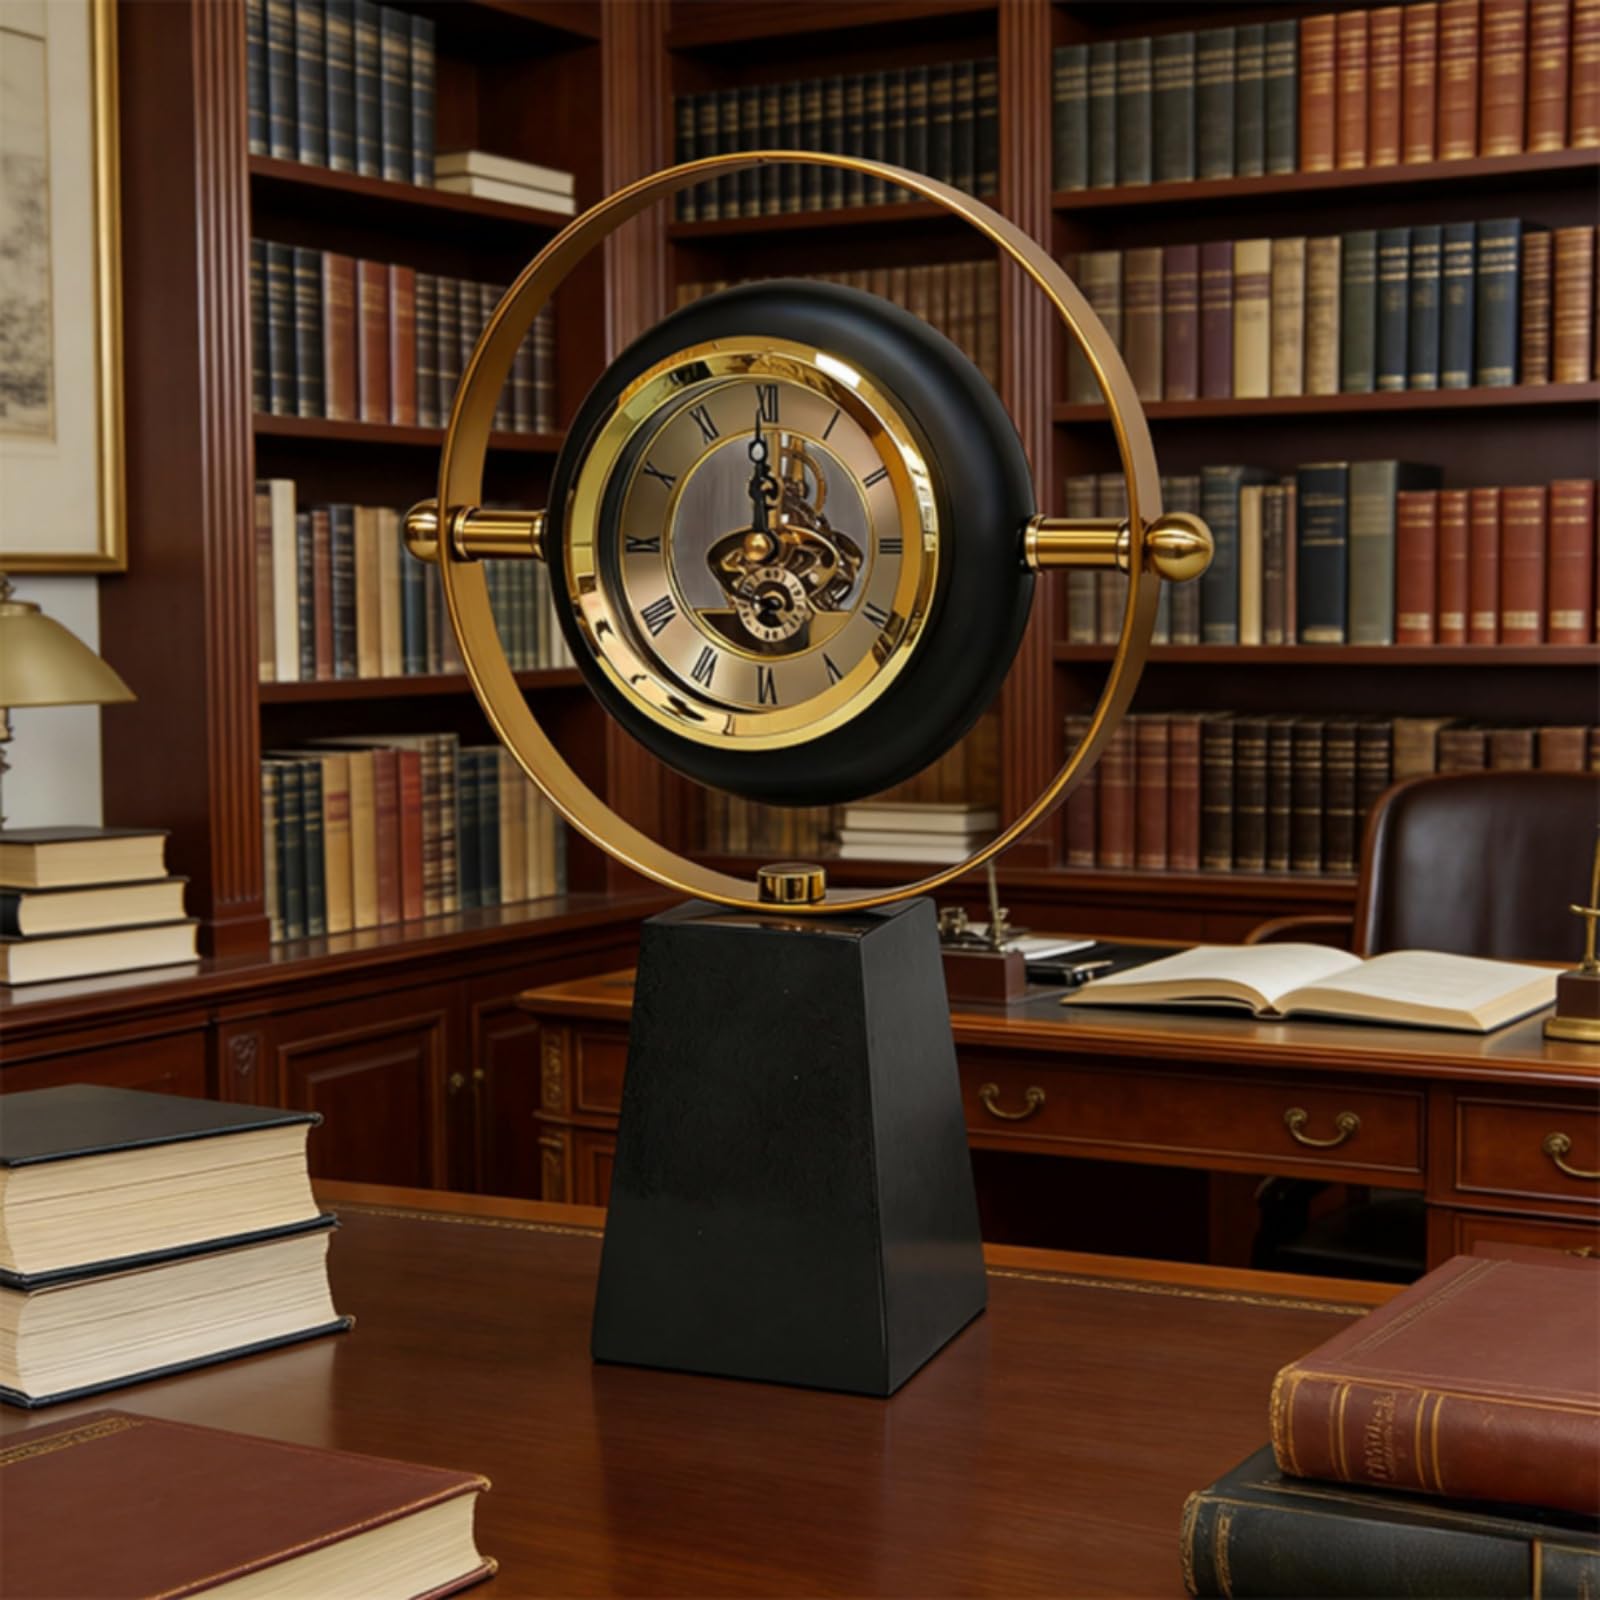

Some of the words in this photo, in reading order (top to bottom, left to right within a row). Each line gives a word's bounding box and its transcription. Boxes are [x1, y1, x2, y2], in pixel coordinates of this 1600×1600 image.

[756, 384, 779, 424] XII
[689, 404, 720, 445] XI
[643, 461, 677, 490] X
[863, 465, 889, 488] II
[625, 535, 661, 553] IX
[879, 538, 904, 554] III
[640, 594, 677, 638] VIII
[757, 665, 778, 705] VI
[822, 652, 844, 686] V
